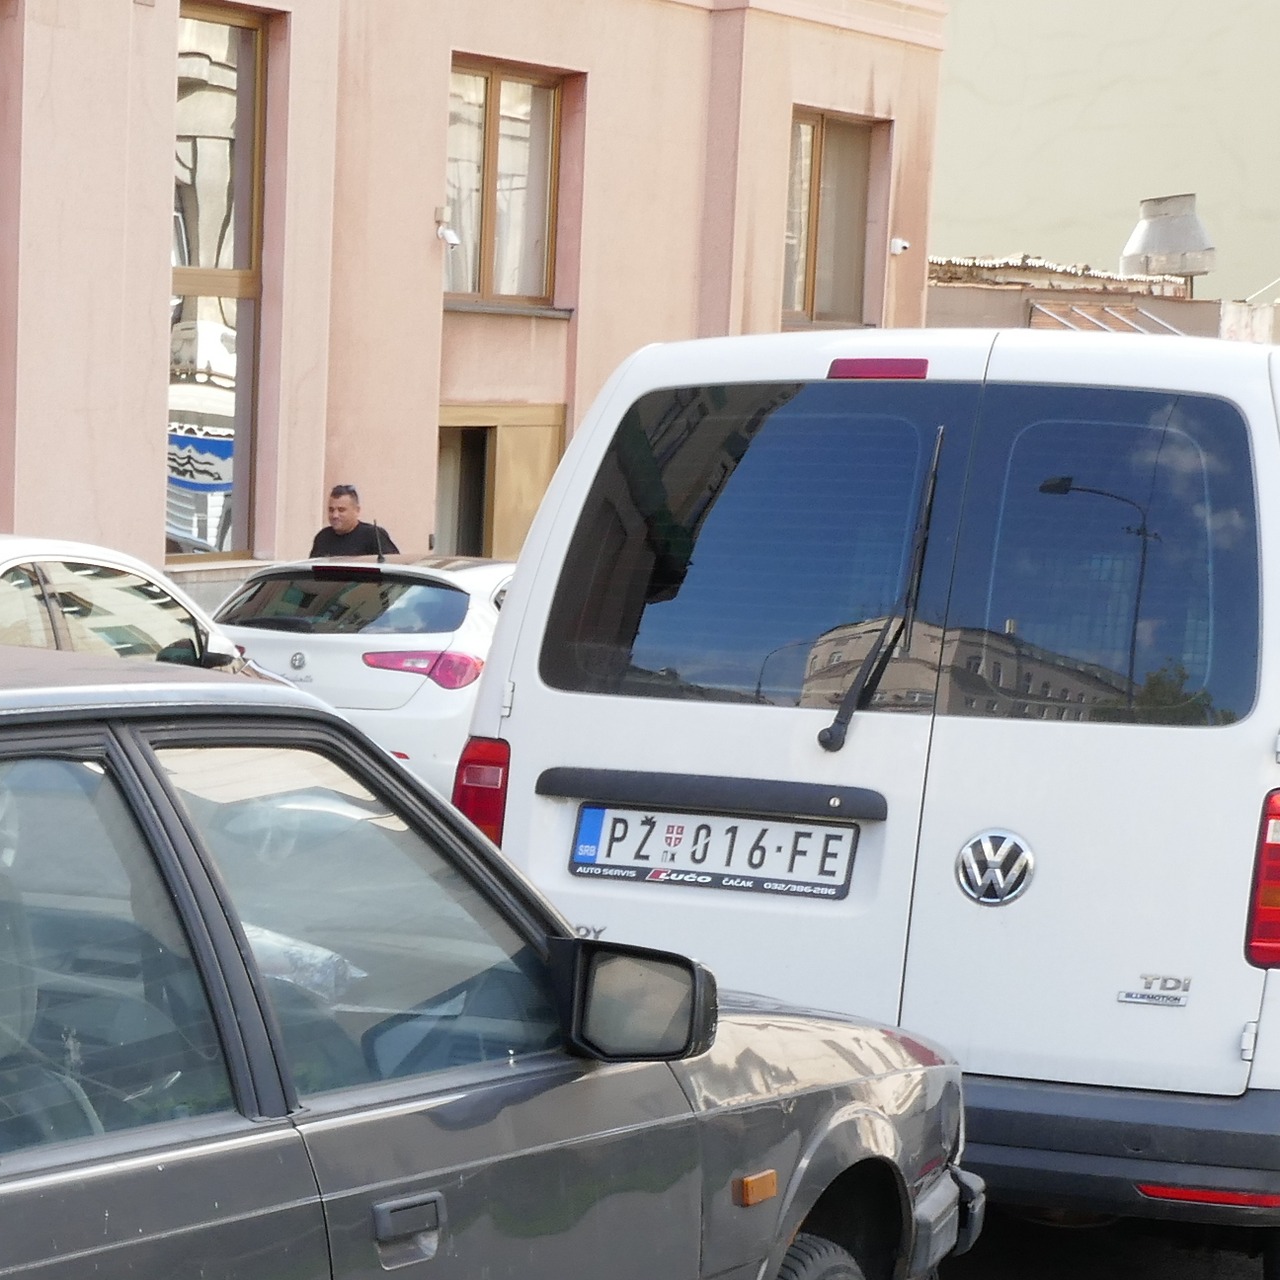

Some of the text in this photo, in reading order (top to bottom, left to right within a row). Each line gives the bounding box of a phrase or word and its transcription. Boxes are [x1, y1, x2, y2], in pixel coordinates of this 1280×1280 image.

[605, 815, 657, 861] PŽ
[578, 844, 596, 857] SRB
[576, 866, 601, 875] AUTO
[602, 868, 636, 878] SERVIS
[722, 877, 754, 888] ČAČAK
[1140, 974, 1192, 992] TDI
